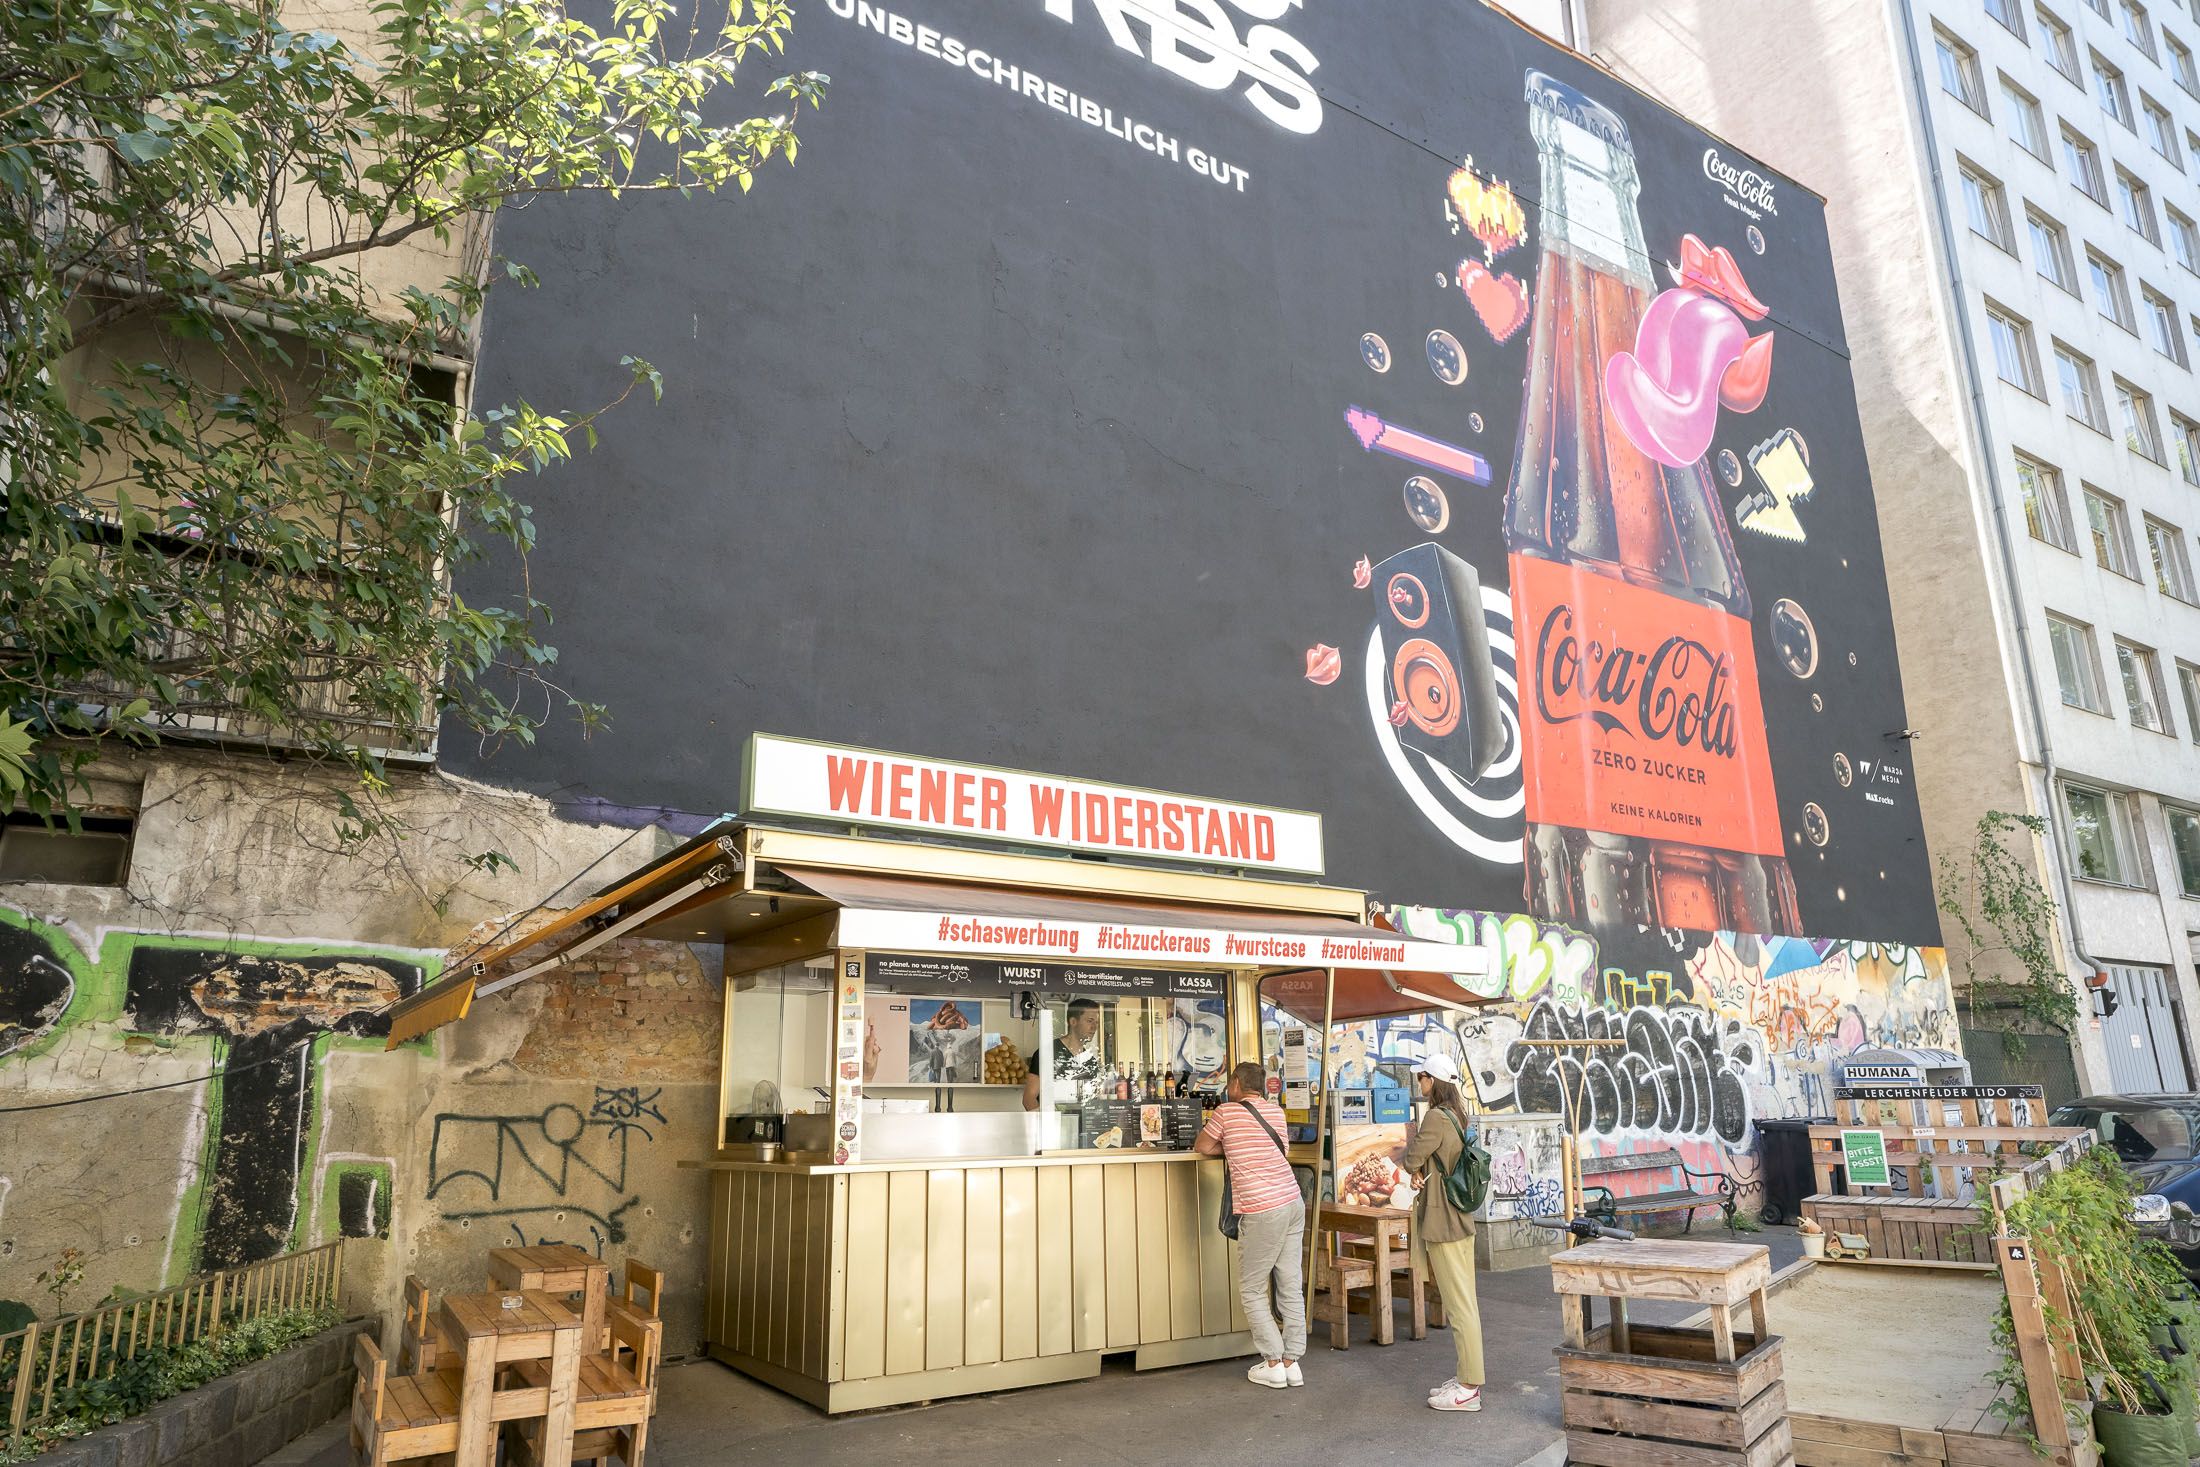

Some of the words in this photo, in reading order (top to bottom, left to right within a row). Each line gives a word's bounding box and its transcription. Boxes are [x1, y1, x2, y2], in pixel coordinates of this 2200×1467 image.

[828, 0, 1179, 163] UNBESCHREIBLICH
[1187, 147, 1250, 192] GUT
[1592, 748, 1636, 772] ZERO
[1643, 758, 1707, 785] ZUCKER
[827, 755, 1007, 831] WIENER
[1031, 783, 1275, 861] WIDERSTAND
[1610, 802, 1645, 818] KEINE
[1648, 808, 1703, 828] KALORIEN
[938, 915, 1080, 953] #schaswerbung
[1097, 926, 1211, 954] #ichzuckeraus
[1225, 933, 1306, 959] #wurstcase
[1321, 938, 1406, 963] #zeroleiwand
[1003, 966, 1042, 979] WURST
[1179, 976, 1213, 988] KASSA
[1847, 1067, 1911, 1079] HUMANA
[1864, 1088, 1968, 1098] LERCHENFELDER
[1975, 1087, 2007, 1097] LIDO
[1847, 1146, 1874, 1158] BITTE
[1851, 1155, 1884, 1169] PSSST!
